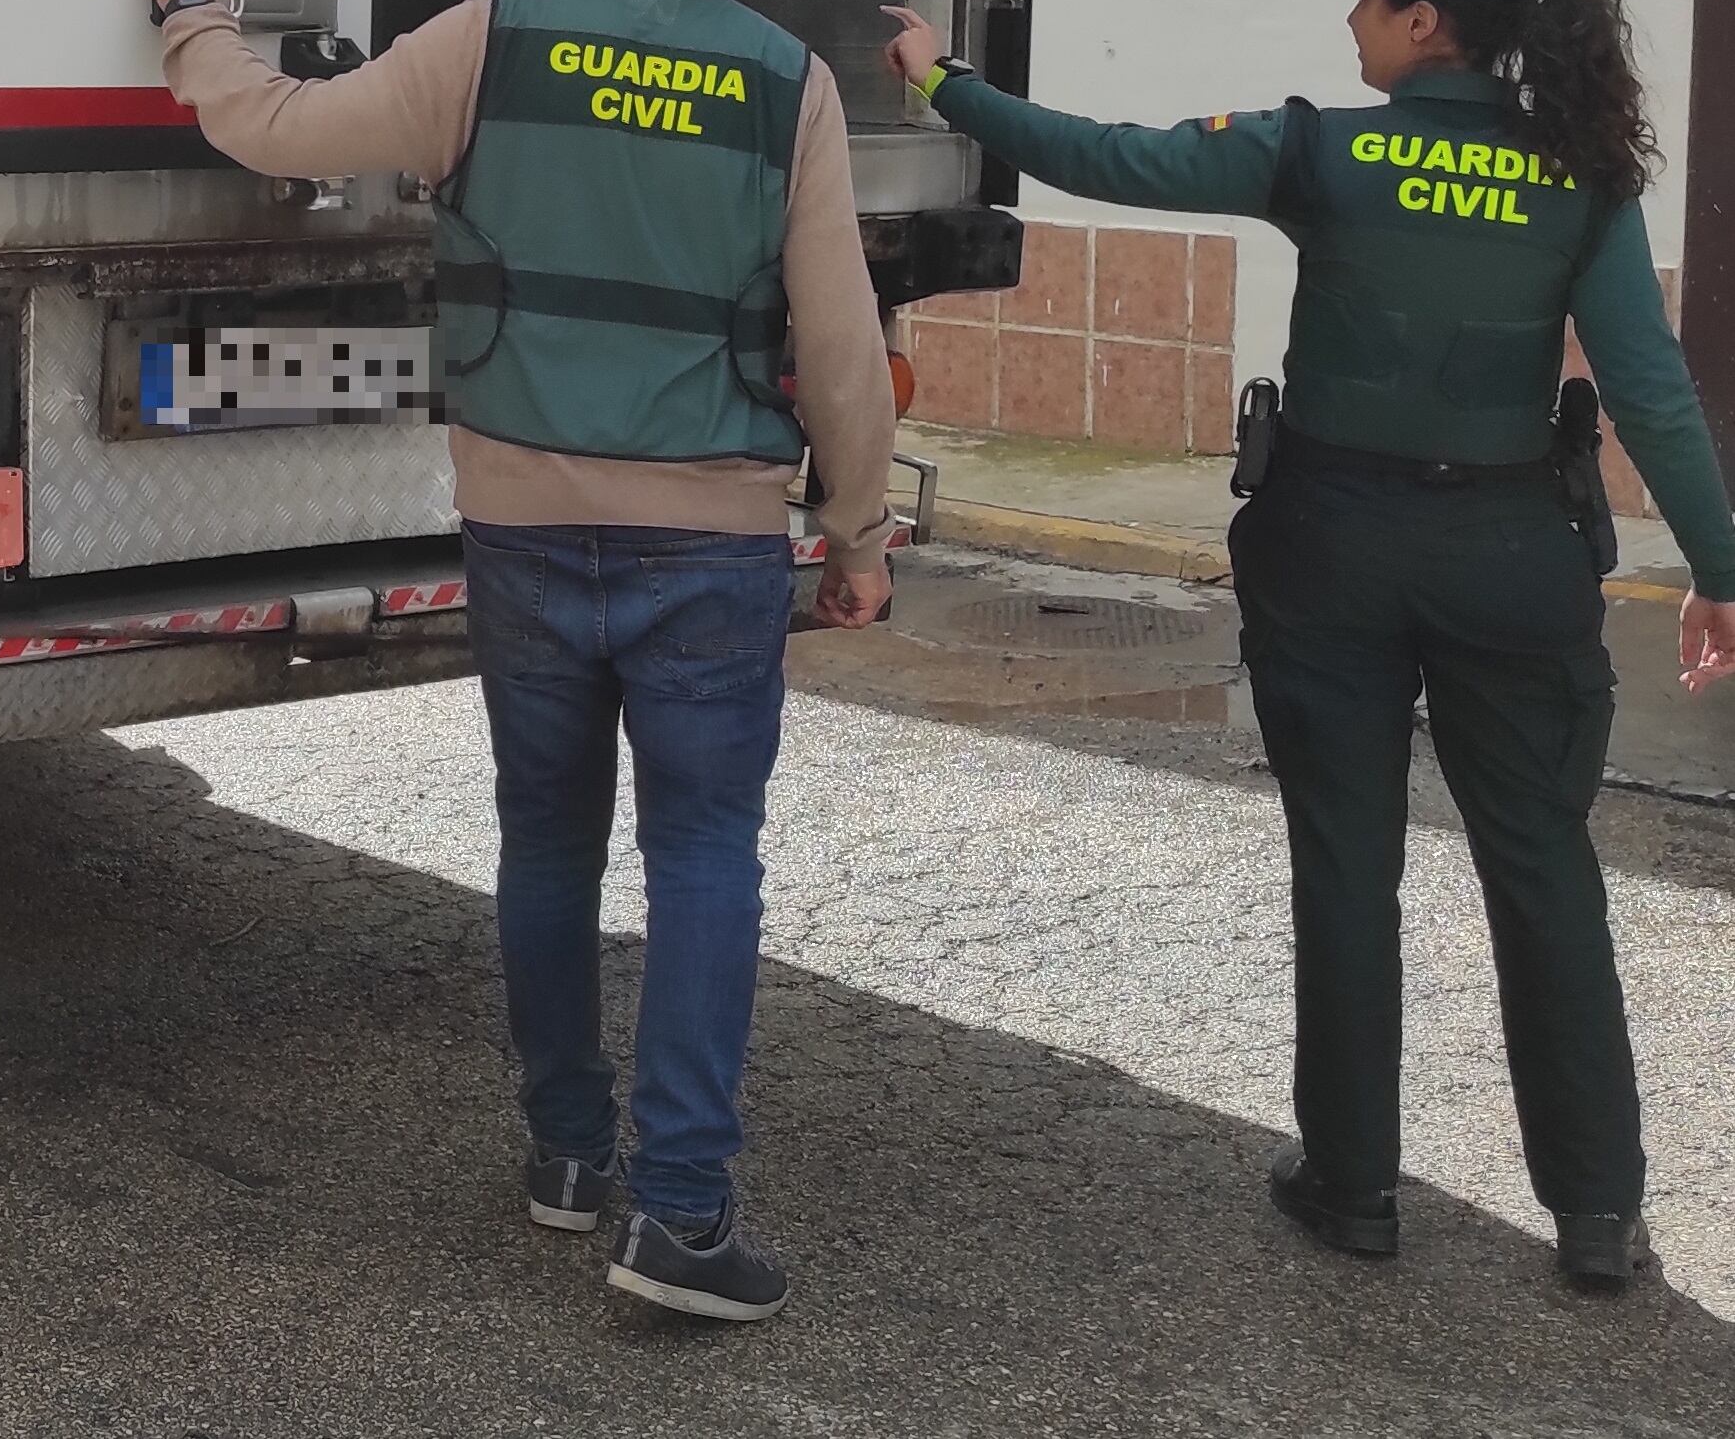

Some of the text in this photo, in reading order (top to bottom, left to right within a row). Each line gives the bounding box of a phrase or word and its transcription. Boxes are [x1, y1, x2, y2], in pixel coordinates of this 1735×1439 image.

[549, 41, 746, 103] GUARDIA
[591, 87, 703, 135] CIVIL
[1398, 177, 1529, 225] CIVIL
